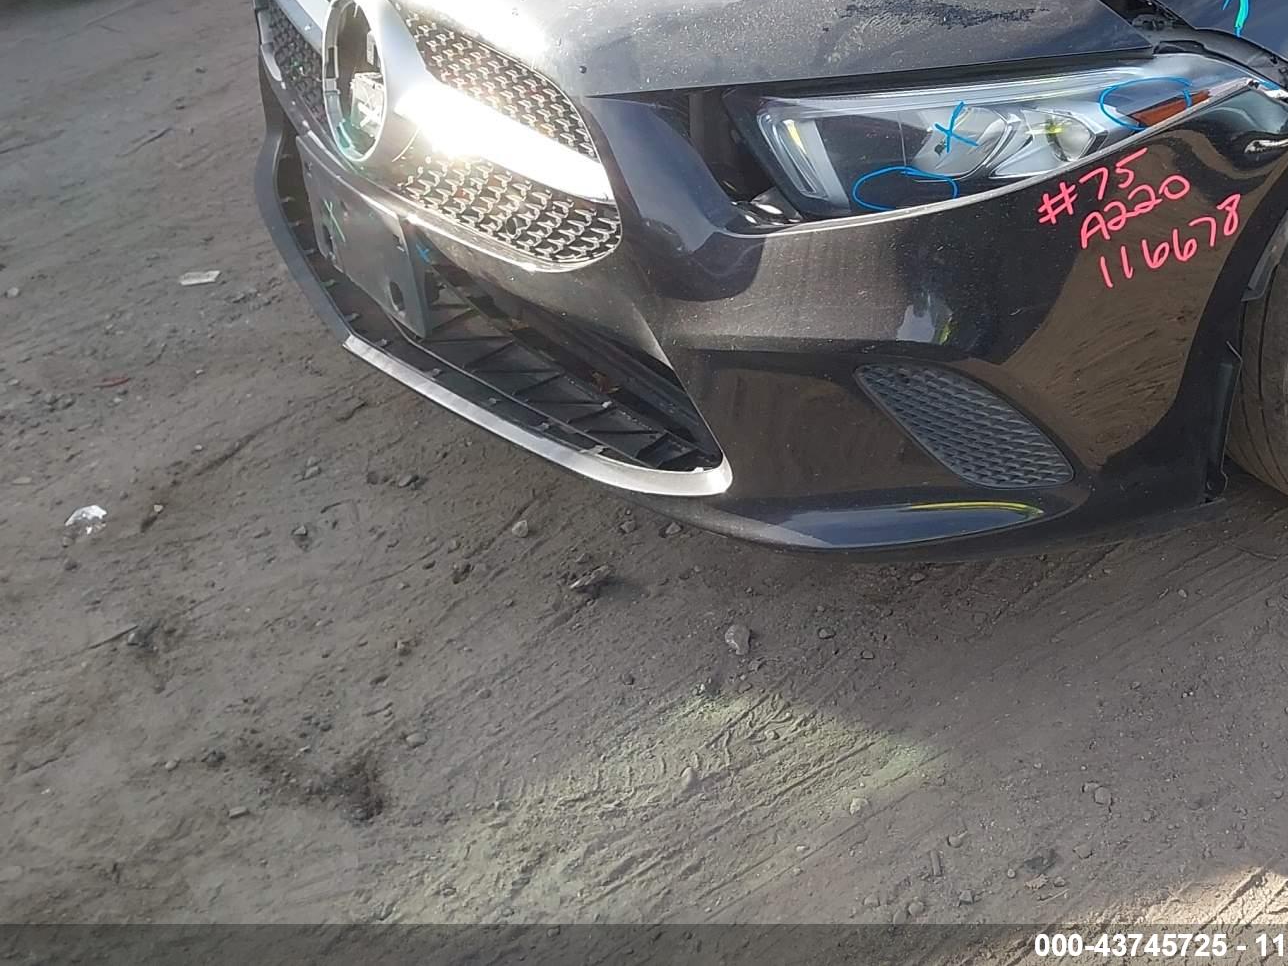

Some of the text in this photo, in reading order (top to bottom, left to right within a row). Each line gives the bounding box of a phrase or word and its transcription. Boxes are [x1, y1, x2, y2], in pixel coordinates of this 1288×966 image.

[1037, 147, 1149, 224] #75
[1080, 174, 1191, 250] A220
[1099, 193, 1242, 288] 116678
